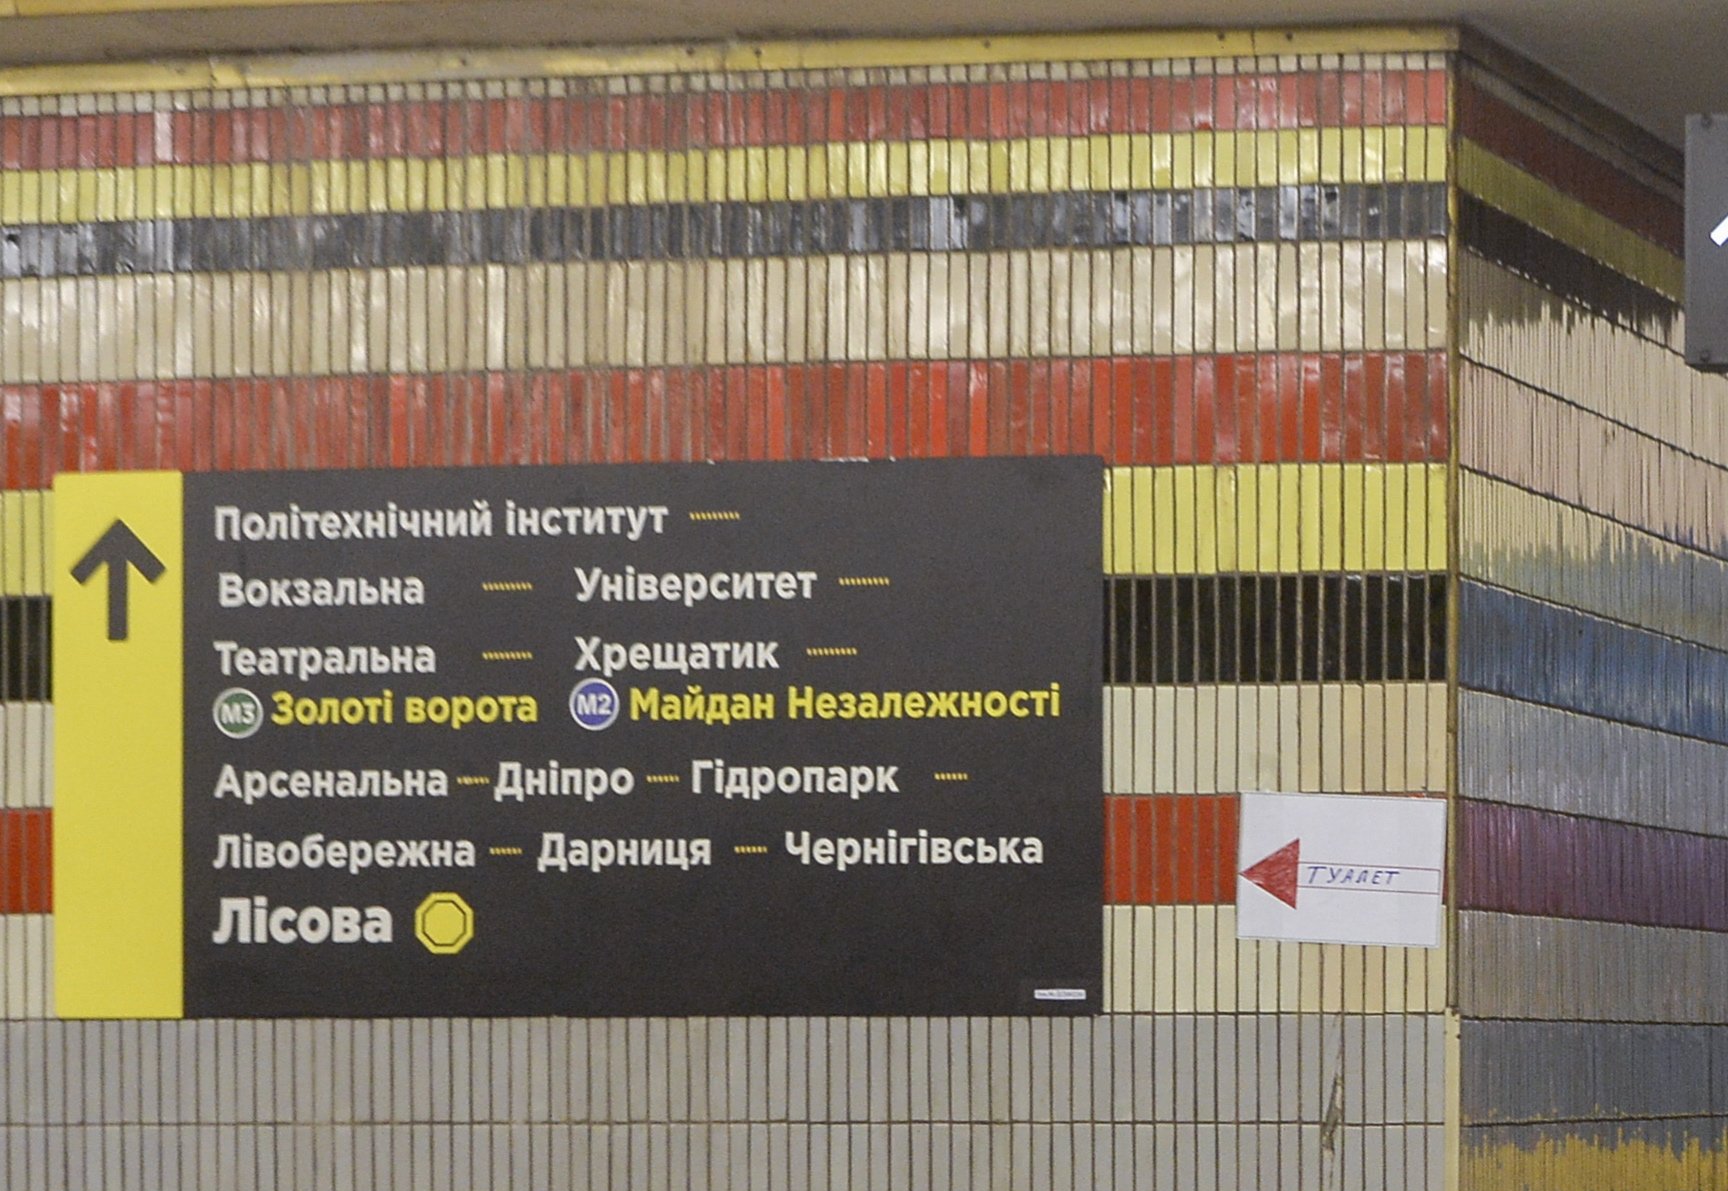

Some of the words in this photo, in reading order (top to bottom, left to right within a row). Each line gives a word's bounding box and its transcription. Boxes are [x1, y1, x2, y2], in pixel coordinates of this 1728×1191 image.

[215, 500, 492, 541] Політехнічний
[506, 500, 669, 540] інститут
[219, 573, 424, 607] Вокзальна
[574, 566, 817, 607] Університет
[213, 641, 435, 681] Театральна
[575, 637, 779, 677] Хрещатик
[271, 689, 392, 725] Золоті
[405, 696, 537, 729] ворота
[631, 685, 774, 725] Майдан
[789, 683, 1059, 719] Незалежності
[214, 764, 448, 804] Арсенальна
[494, 760, 634, 802] Дніпро
[692, 759, 899, 800] Гідропарк
[213, 833, 475, 874] Лівобережна
[538, 832, 711, 872] Дарниця
[786, 829, 1043, 871] Чернігівська
[1307, 865, 1400, 885] ТУАЛЕТ
[213, 896, 392, 943] Лісова
